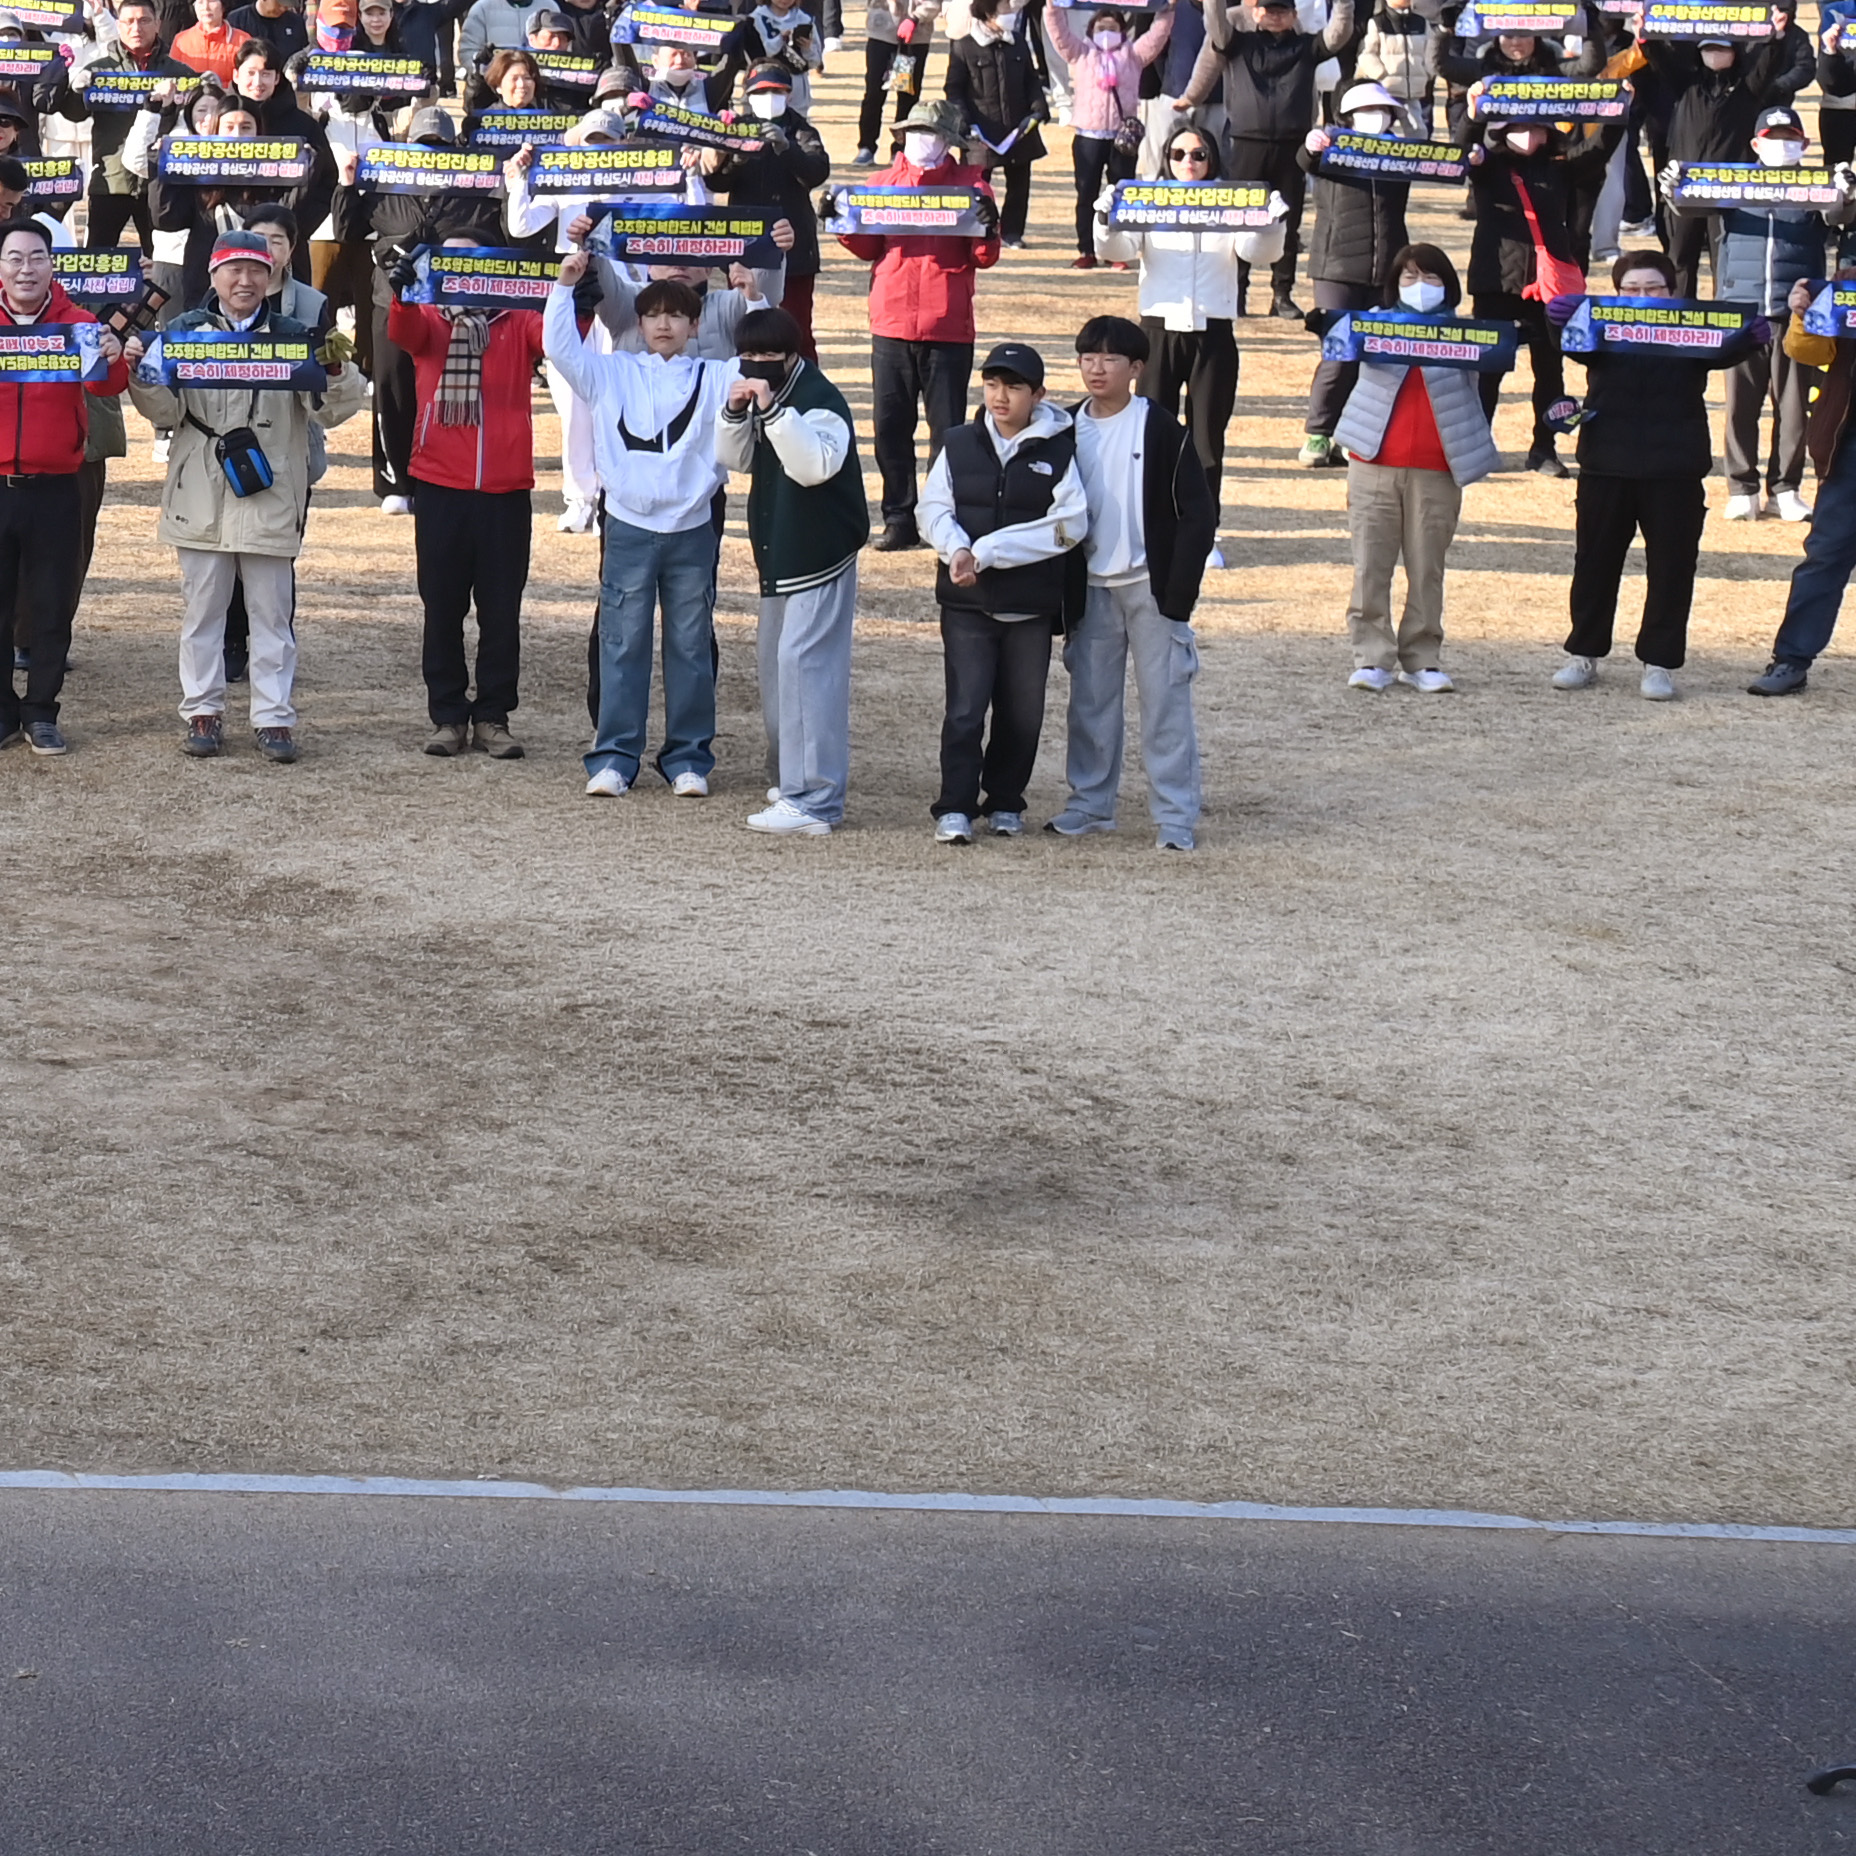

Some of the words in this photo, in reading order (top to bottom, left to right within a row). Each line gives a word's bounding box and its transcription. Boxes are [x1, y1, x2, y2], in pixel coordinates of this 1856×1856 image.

[169, 142, 297, 159] 우주항공산업진흥원
[539, 150, 673, 170] 우주항공산업진흥원
[1121, 187, 1265, 207] 우주항공산업진흥원
[861, 209, 899, 225] 조속히
[898, 210, 958, 225] 제정하라!!
[612, 219, 702, 235] 우주항공복합도시
[703, 221, 727, 235] 건설
[729, 220, 764, 235] 특별법
[626, 237, 672, 255] 조속히
[672, 238, 745, 255] 제정하라!!
[1590, 305, 1679, 325] 우주항공복합도시
[1681, 311, 1705, 326] 건설
[1707, 312, 1742, 328] 특별법
[1351, 319, 1438, 339] 우주항공복합도시
[1439, 327, 1463, 341] 건설
[1464, 329, 1499, 344] 특별법
[1605, 324, 1650, 343] 조속히
[1650, 327, 1723, 347] 제정하라!!
[162, 343, 248, 359] 우주항공복합도시
[250, 344, 273, 359] 건설
[275, 344, 309, 359] 특별법
[1364, 337, 1409, 356] 조속히
[1409, 340, 1480, 361] 제정하라!!
[177, 362, 221, 380] 조속히
[221, 362, 291, 380] 제정하라!!
